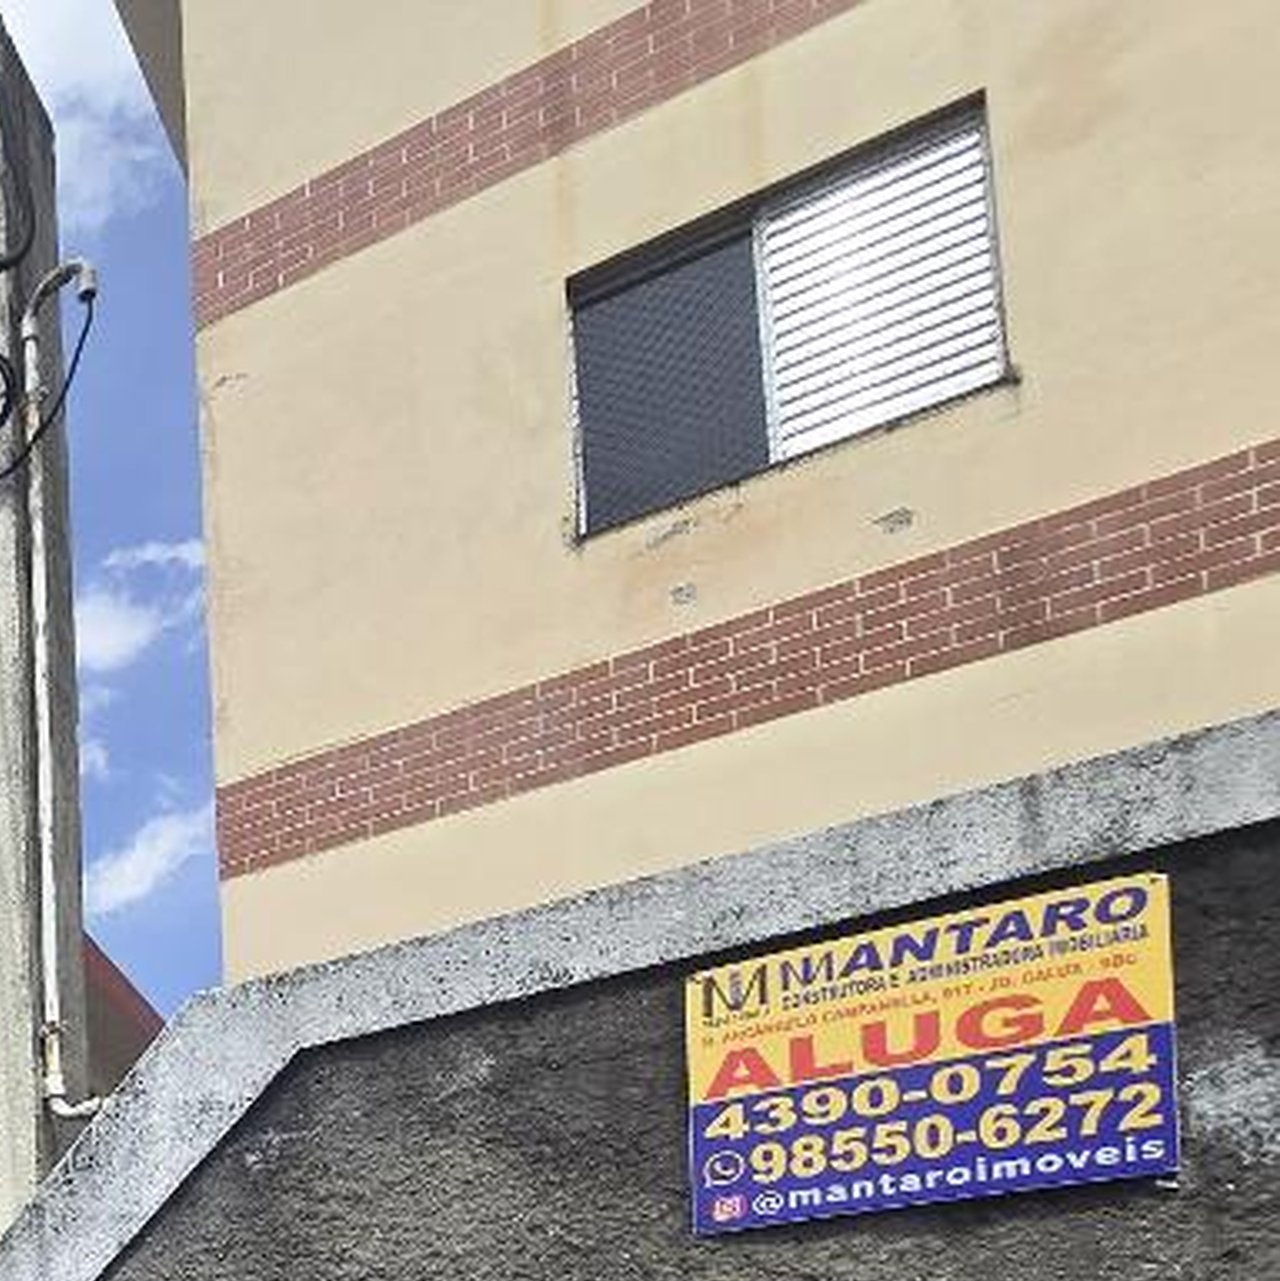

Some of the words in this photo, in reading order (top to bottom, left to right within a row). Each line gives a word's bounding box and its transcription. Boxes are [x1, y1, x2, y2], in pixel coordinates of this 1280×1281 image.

[779, 886, 1148, 991] MANTARO
[703, 976, 1155, 1101] ALUGA
[703, 1033, 1158, 1141] 4390-0754
[749, 1081, 1165, 1185] 98550-6272
[751, 1136, 1167, 1217] @mantaroimoveis
